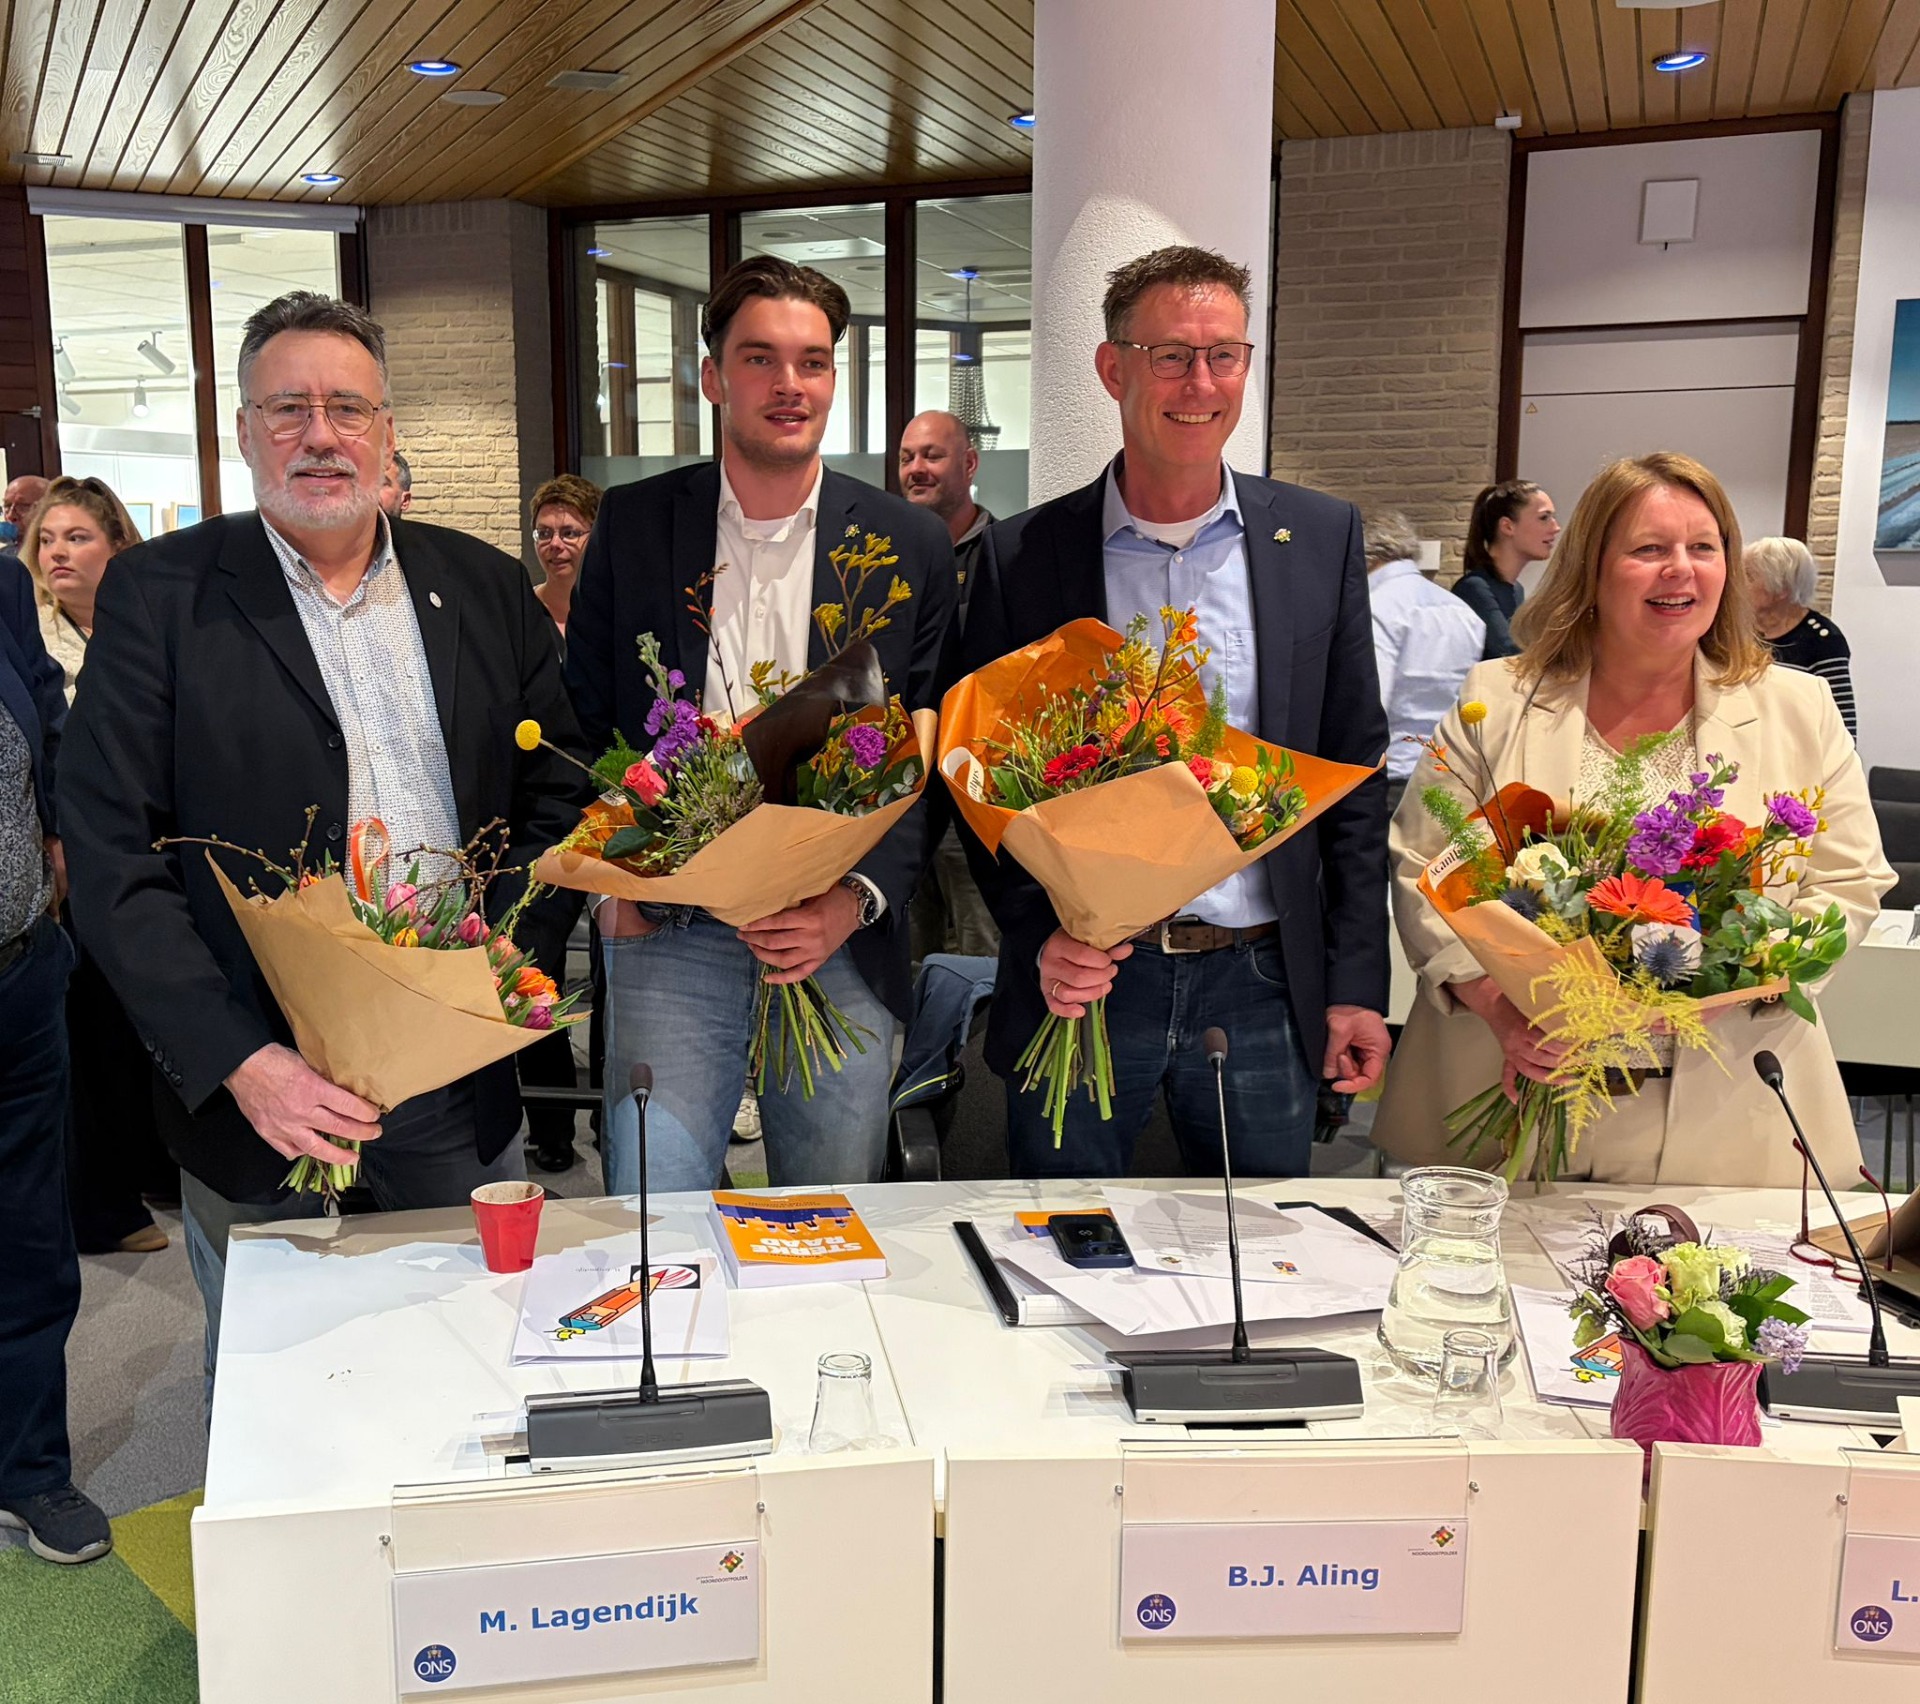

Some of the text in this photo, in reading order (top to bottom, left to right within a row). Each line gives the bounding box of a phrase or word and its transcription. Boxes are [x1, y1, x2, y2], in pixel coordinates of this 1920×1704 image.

[750, 1242, 862, 1254] STERKE
[760, 1235, 846, 1247] RAAD
[1228, 1563, 1379, 1590] B.J. Aling
[1892, 1580, 1919, 1603] L.
[480, 1592, 699, 1634] M. Lagendijk
[1140, 1608, 1172, 1622] ONS
[1854, 1620, 1888, 1635] ONS
[418, 1659, 452, 1675] ONS
